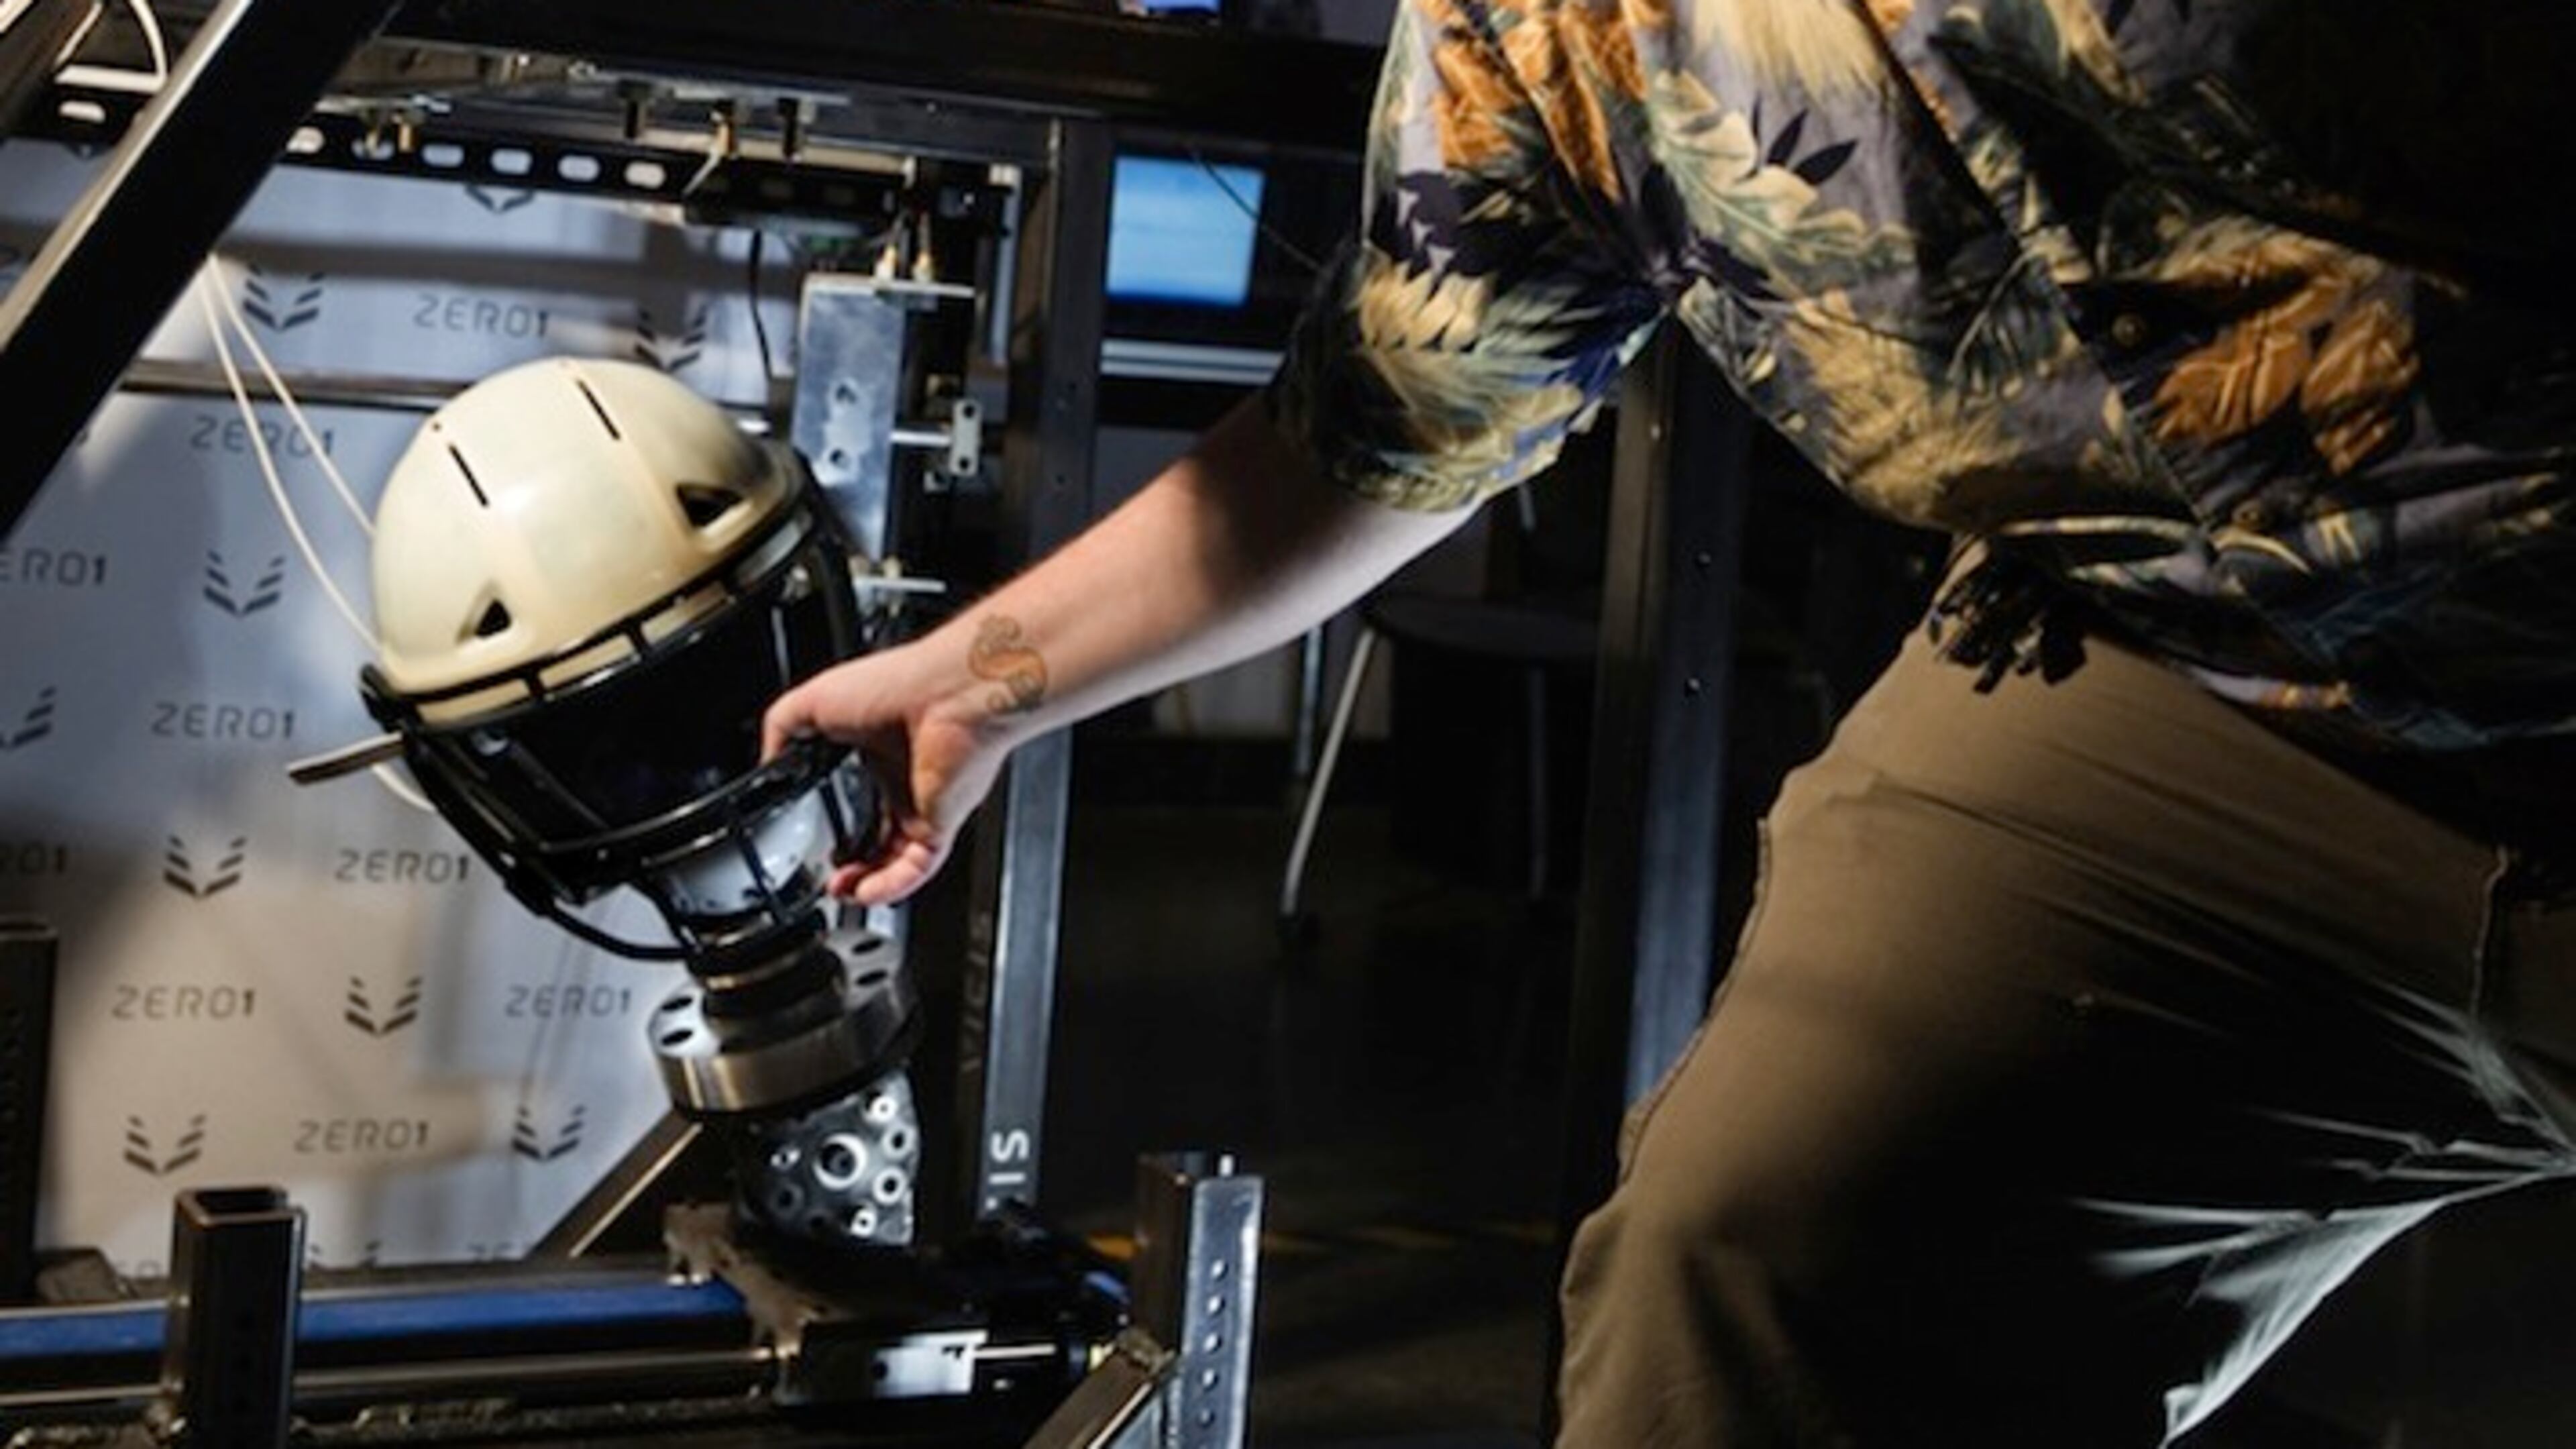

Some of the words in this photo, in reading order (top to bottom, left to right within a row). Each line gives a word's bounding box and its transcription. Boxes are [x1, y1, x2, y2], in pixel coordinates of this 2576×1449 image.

[414, 294, 547, 338] ZERO1
[152, 701, 295, 739] ZERO1
[336, 848, 469, 882] ZERO1
[112, 985, 254, 1018] ZERO1
[505, 985, 631, 1018] ZERO1
[294, 1119, 429, 1152] ZERO1
[985, 1130, 1030, 1210] IS
